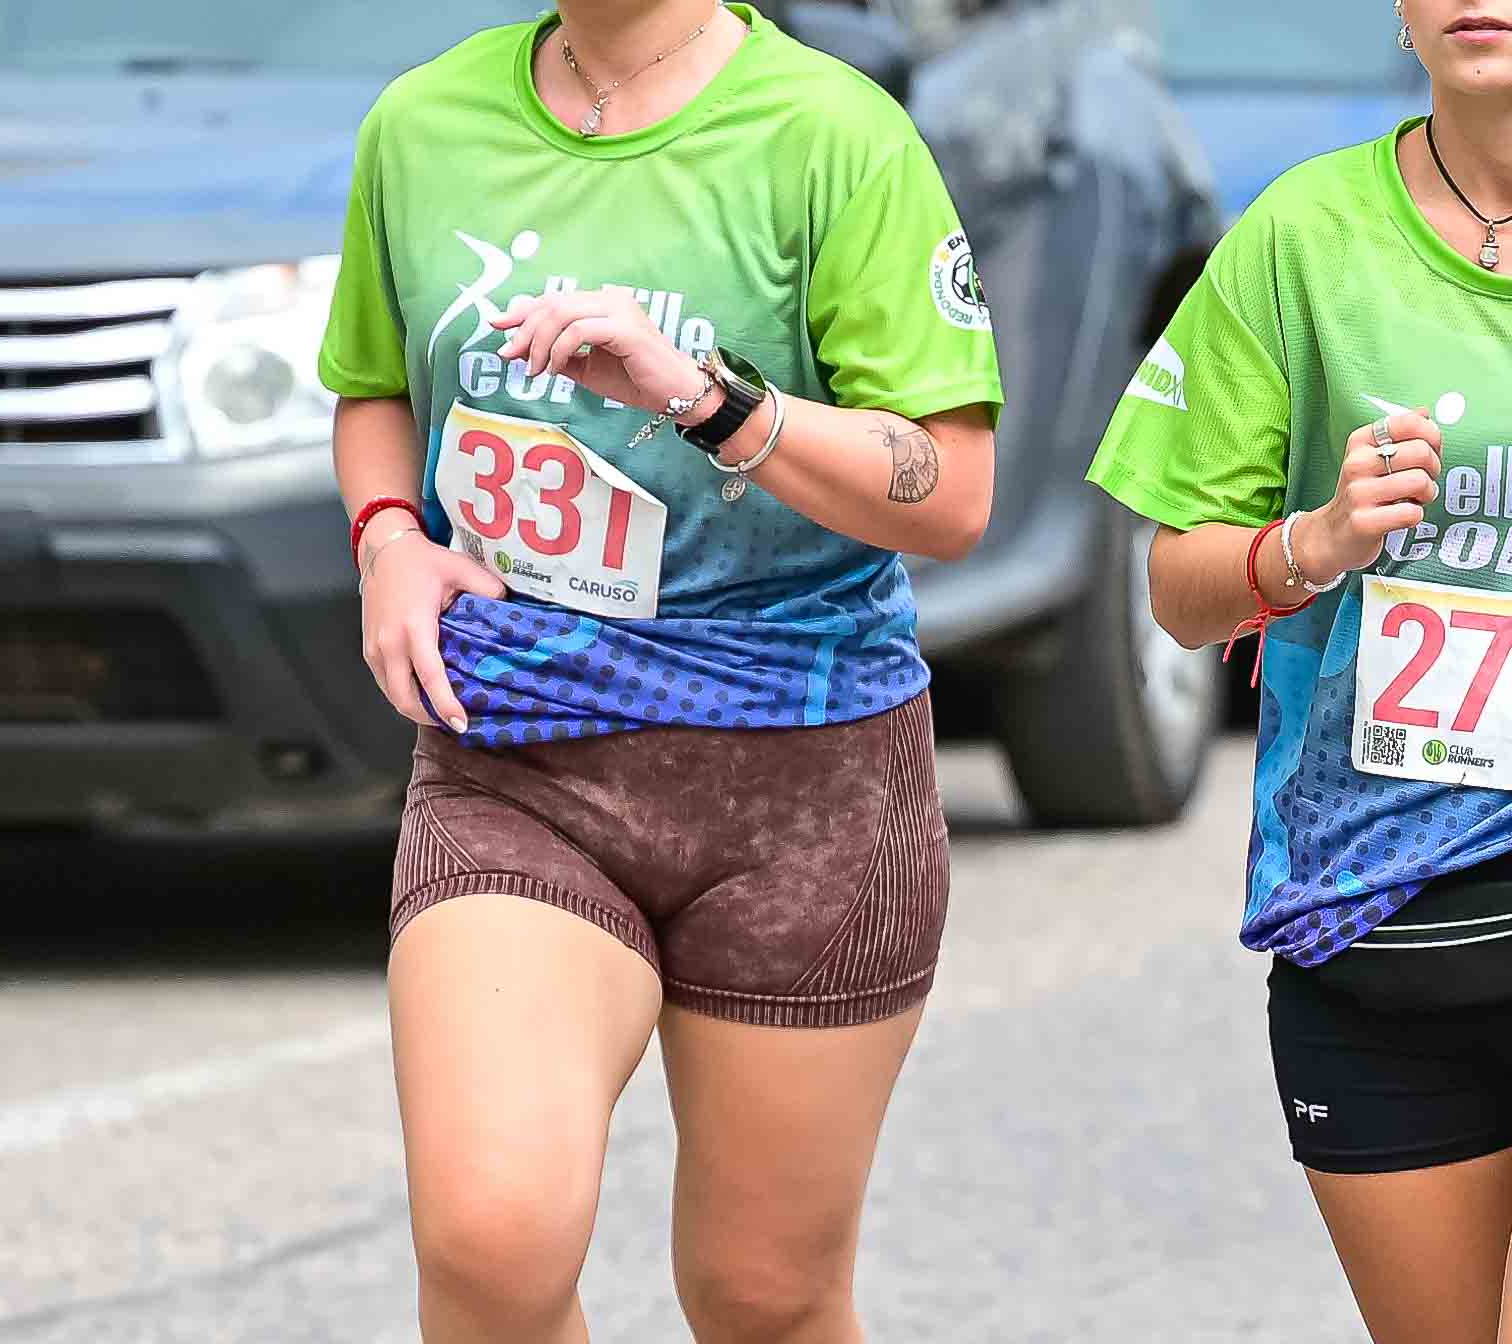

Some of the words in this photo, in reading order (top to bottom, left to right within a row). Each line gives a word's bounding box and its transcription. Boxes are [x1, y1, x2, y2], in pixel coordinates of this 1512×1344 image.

[457, 429, 633, 570] 331
[568, 576, 637, 603] CARUSO
[1448, 744, 1474, 756] CLUB
